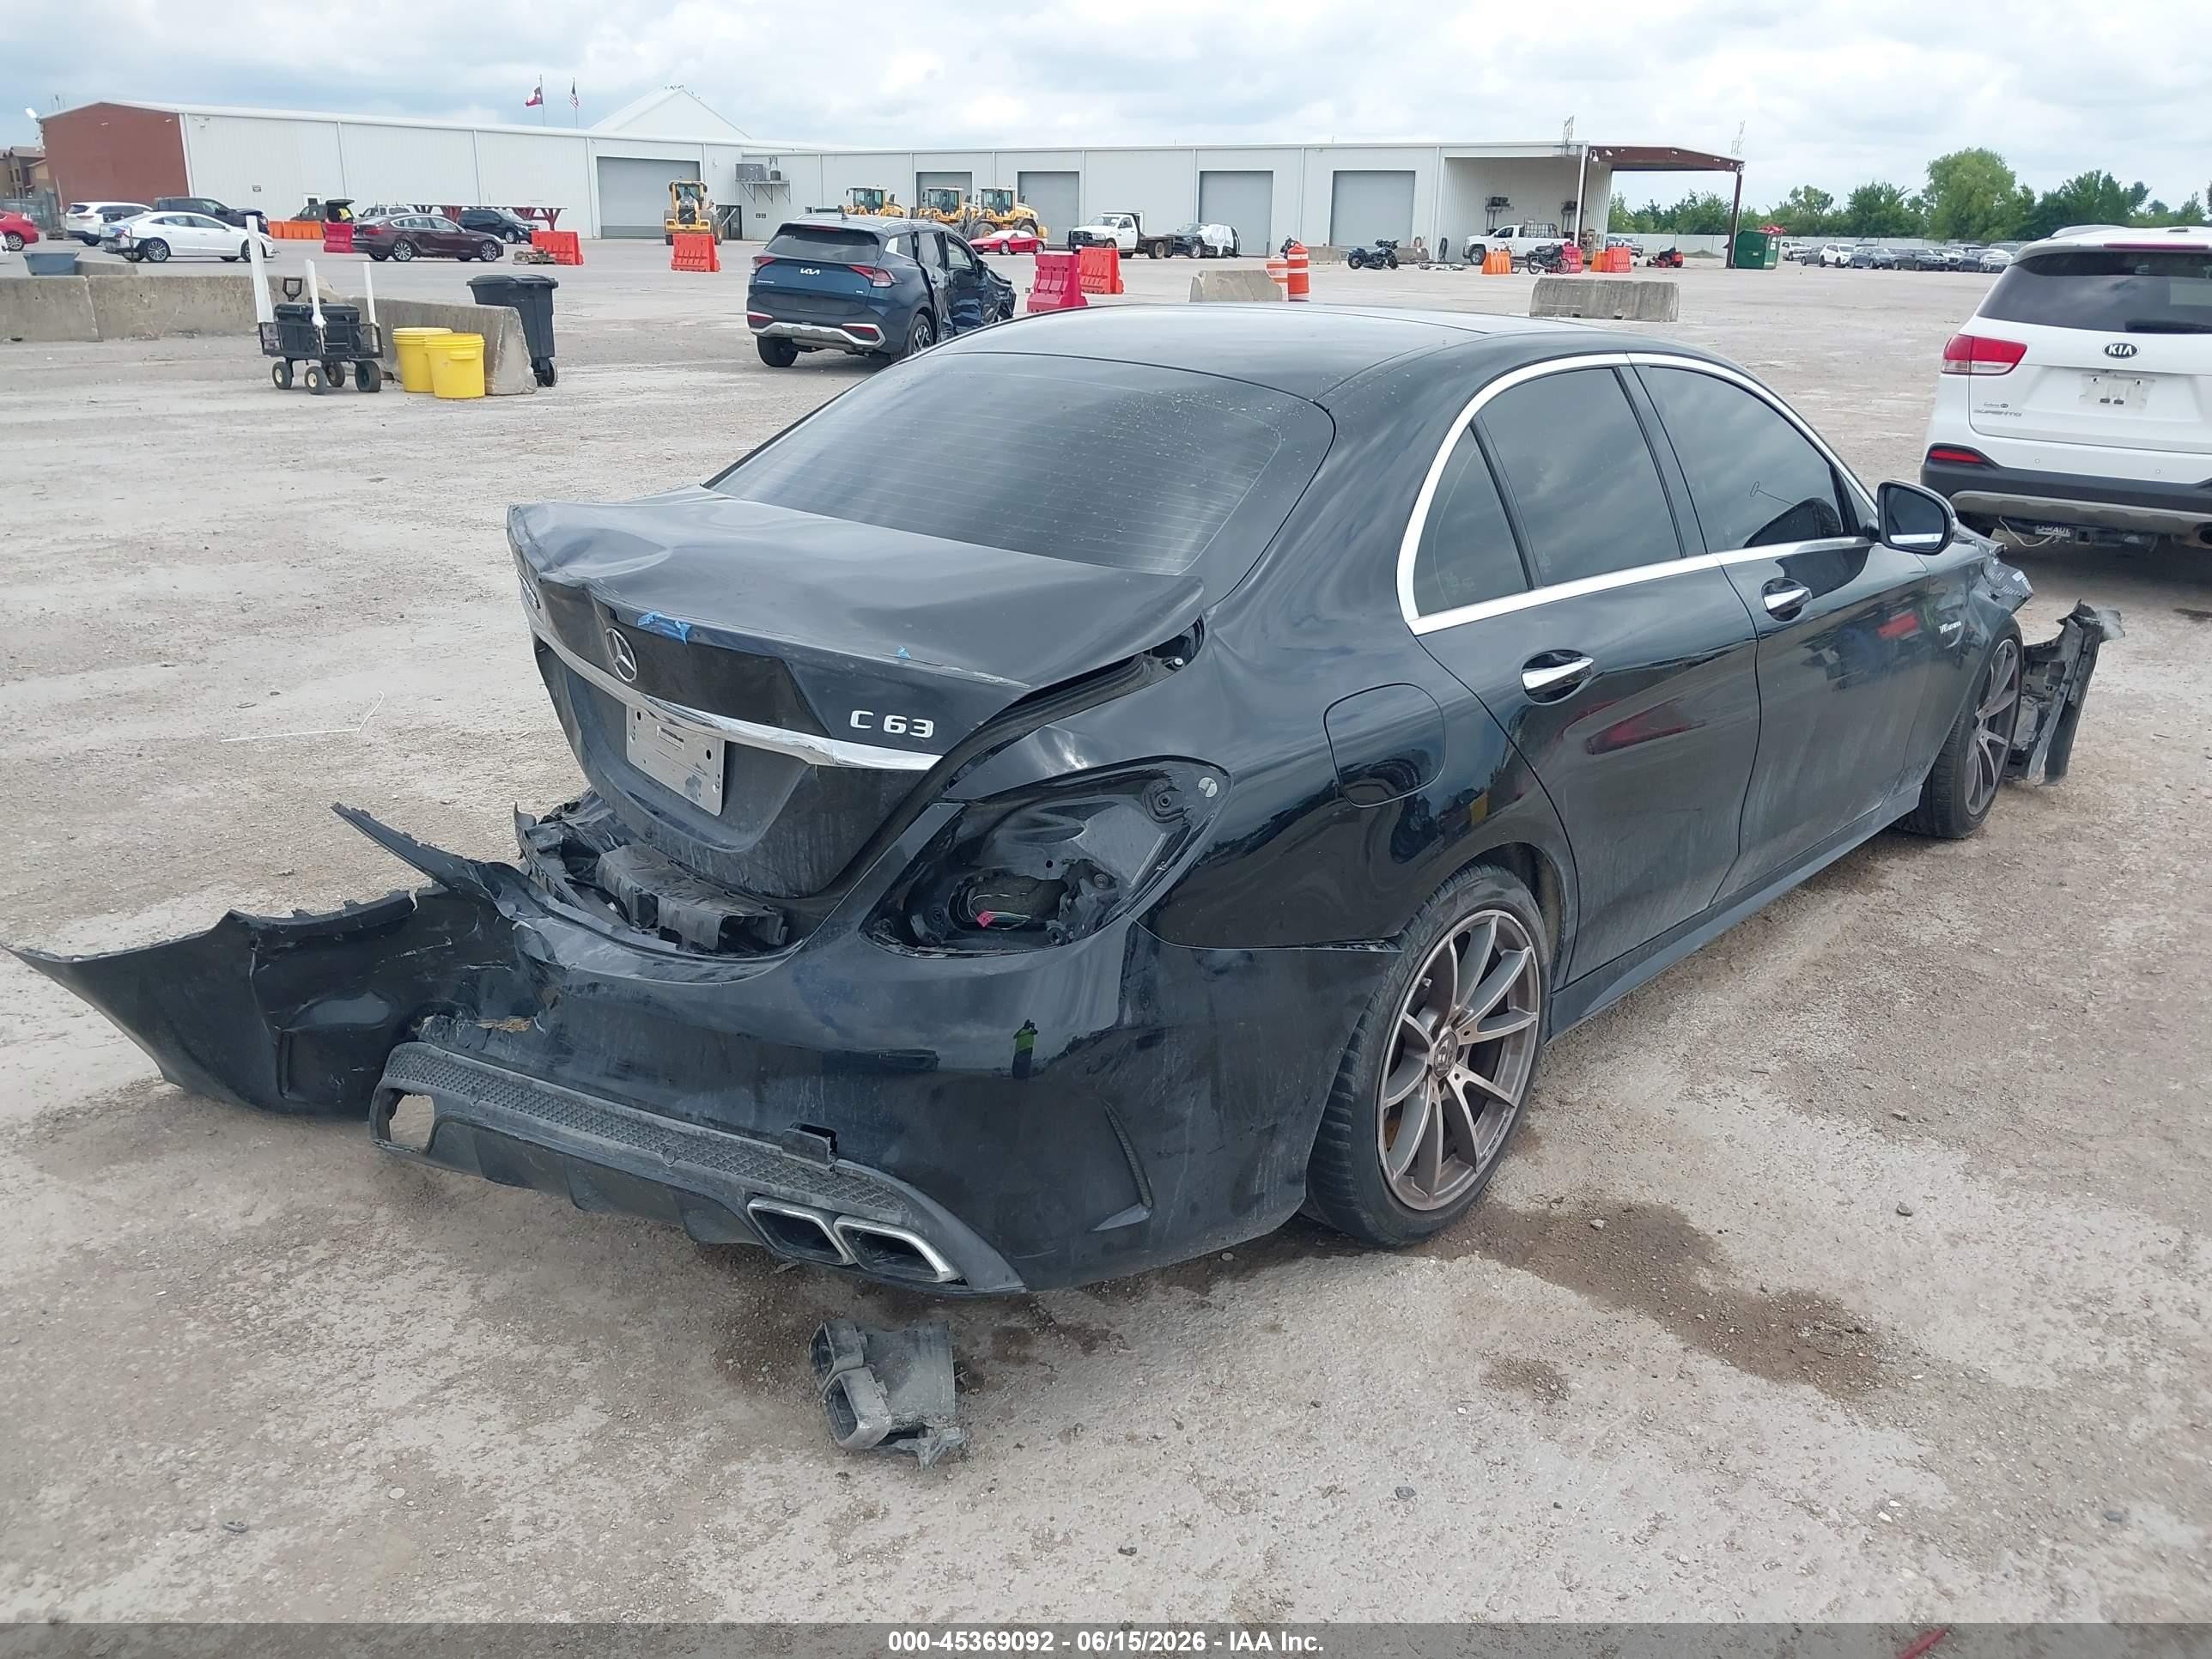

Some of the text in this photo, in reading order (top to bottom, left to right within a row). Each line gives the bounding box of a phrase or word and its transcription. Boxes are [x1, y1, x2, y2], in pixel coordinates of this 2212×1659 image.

[2108, 344, 2133, 355] KIA
[850, 710, 934, 738] C 63
